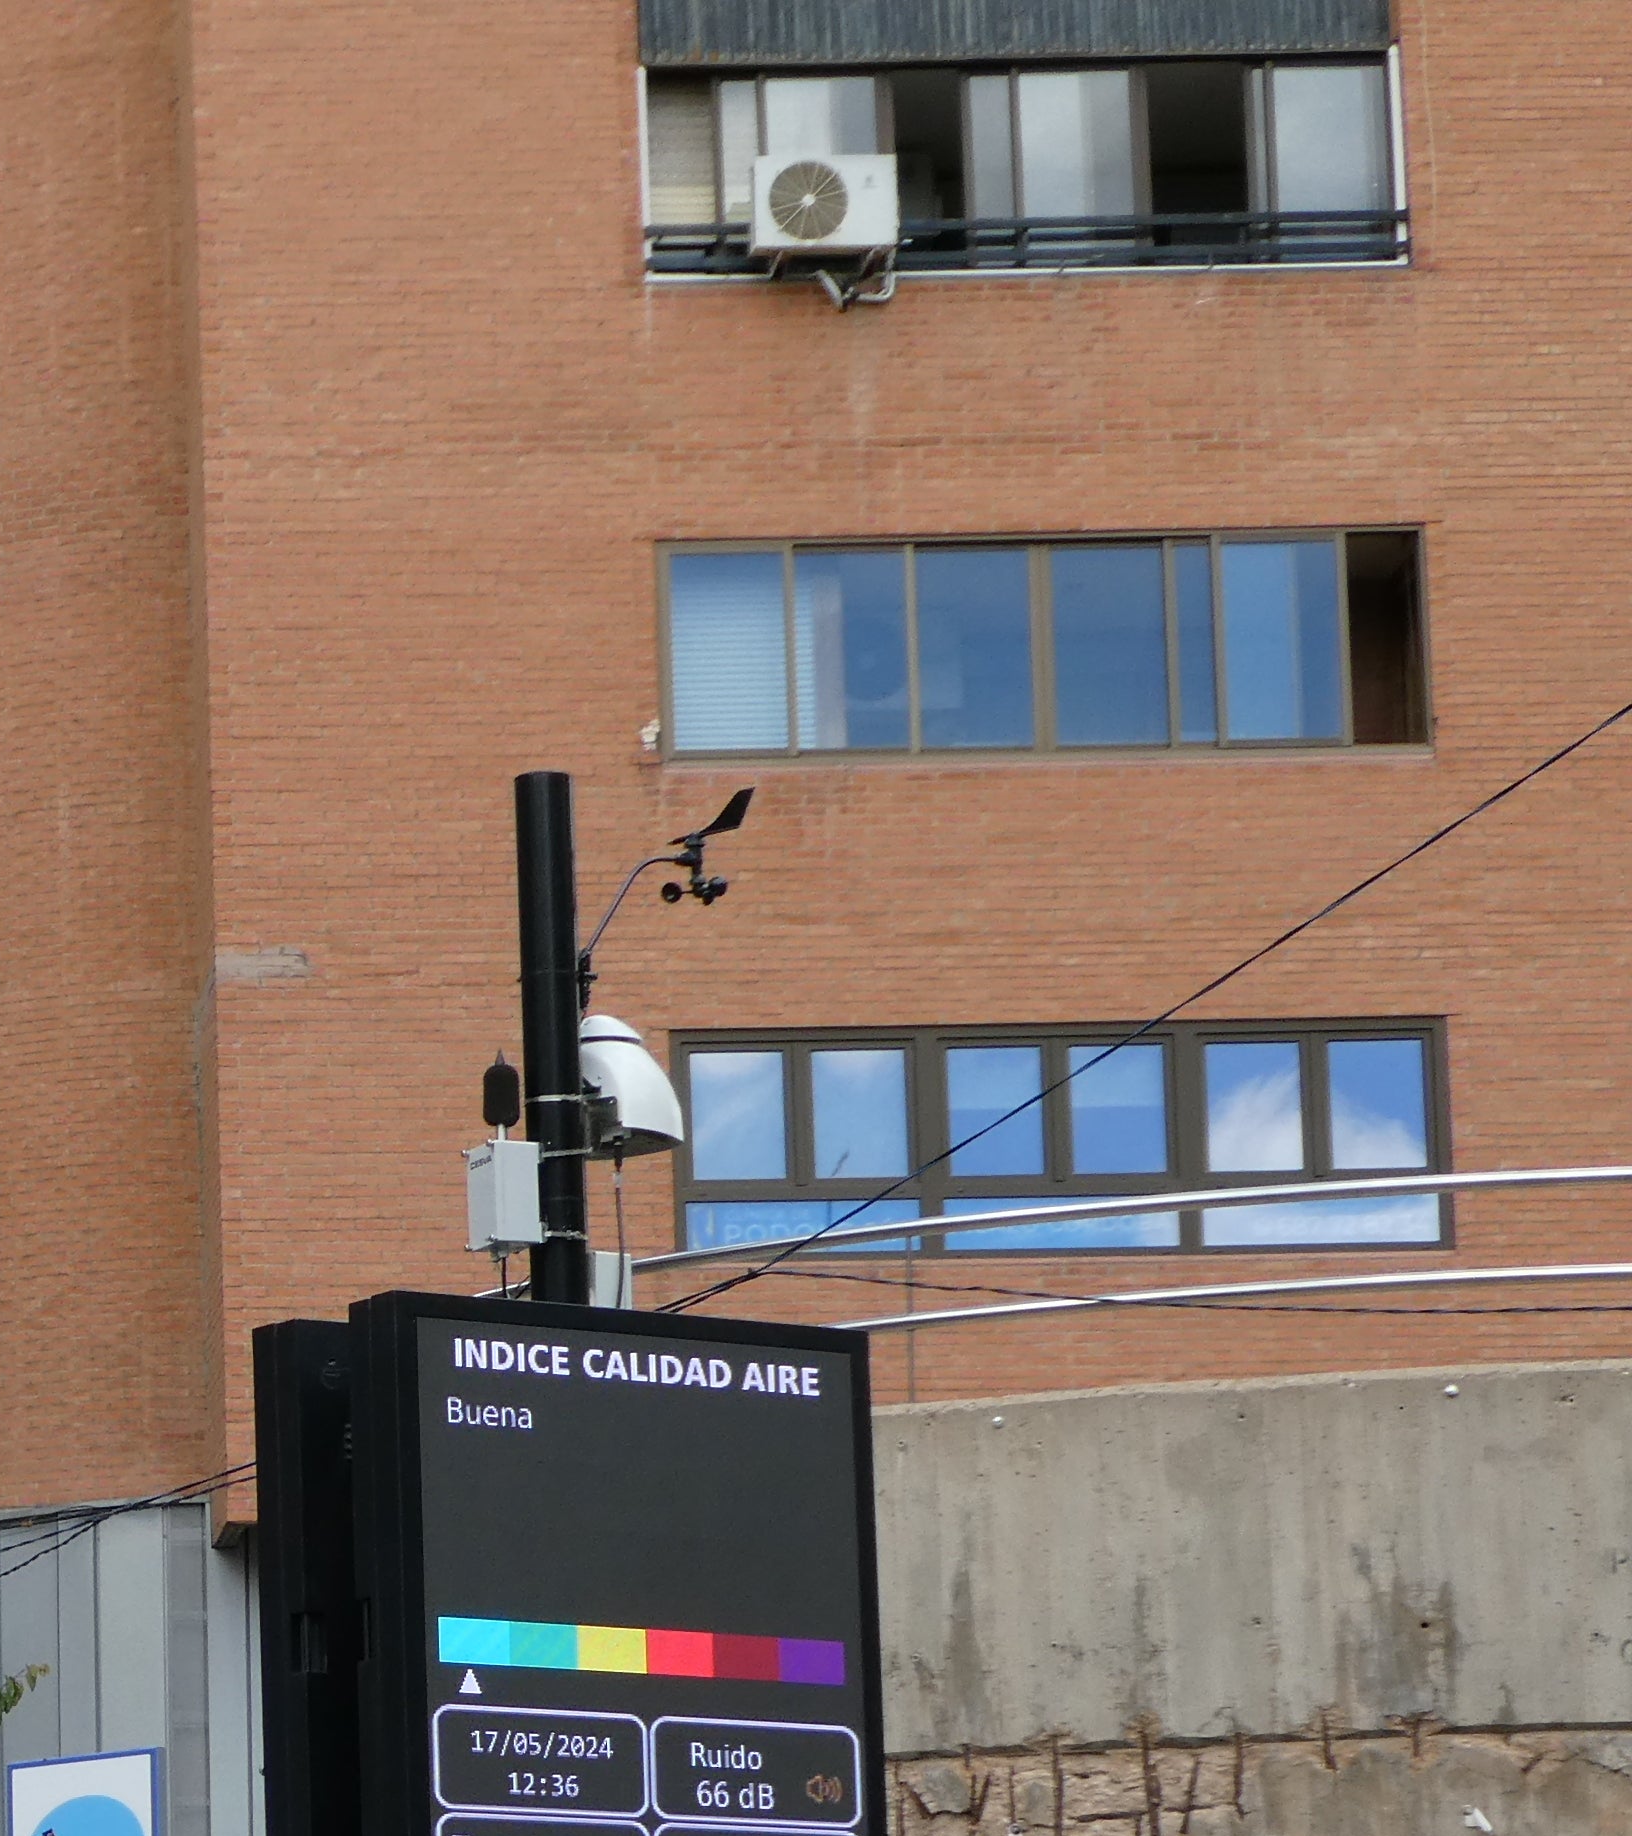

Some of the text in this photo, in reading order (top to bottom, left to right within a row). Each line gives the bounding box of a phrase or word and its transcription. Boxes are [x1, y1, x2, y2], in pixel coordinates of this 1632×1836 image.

[454, 1337, 821, 1397] INDICE CALIDAD AIRE
[446, 1396, 533, 1429] Buena
[471, 1730, 614, 1760] 17/05/2024
[690, 1742, 762, 1770] Ruido
[508, 1772, 579, 1797] 12:36
[696, 1780, 775, 1810] 66 dB
